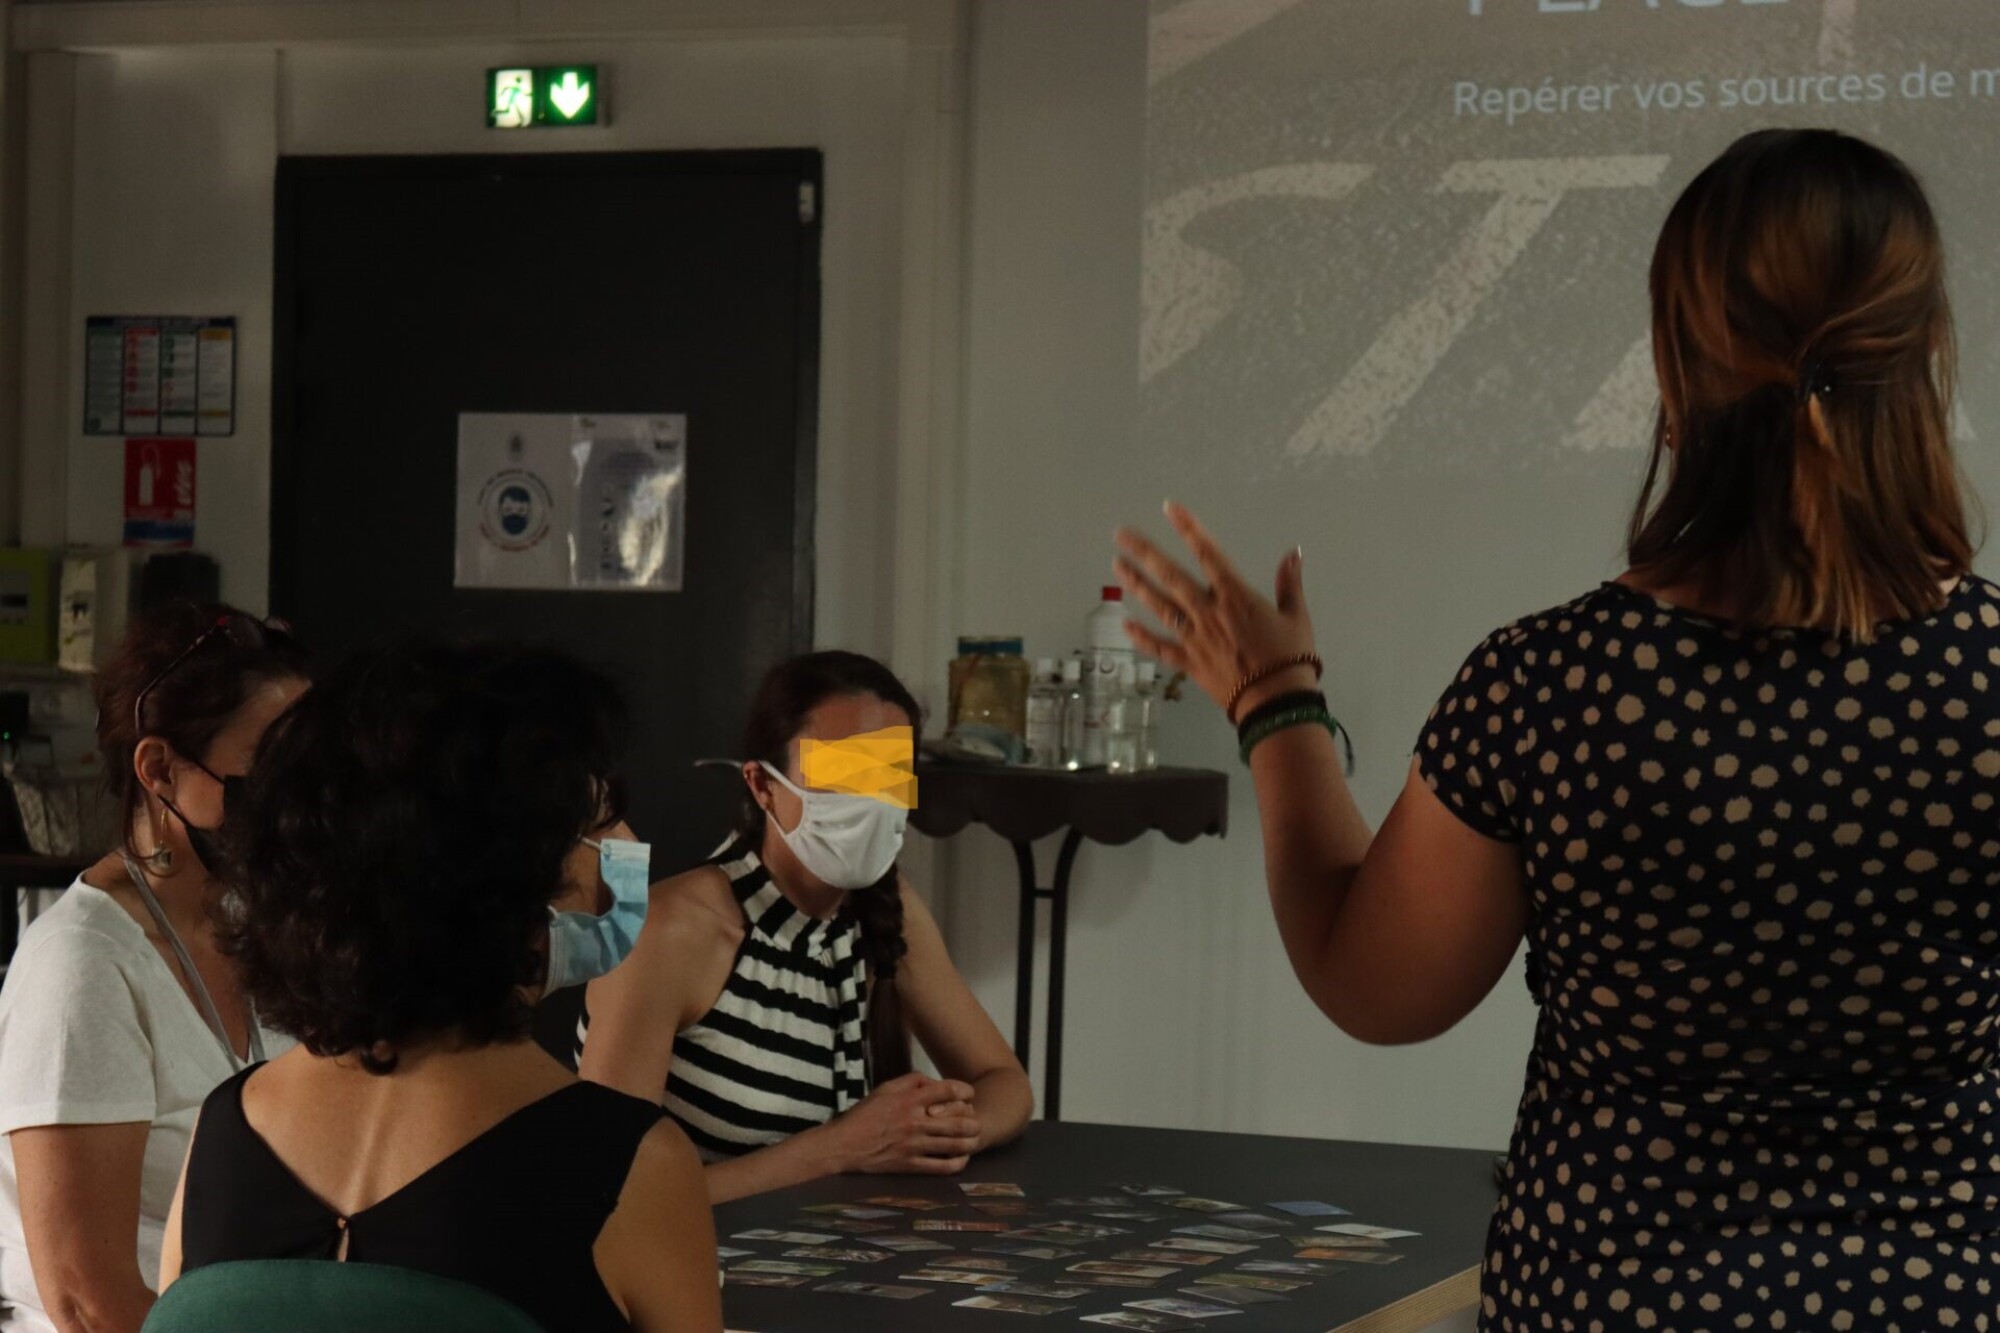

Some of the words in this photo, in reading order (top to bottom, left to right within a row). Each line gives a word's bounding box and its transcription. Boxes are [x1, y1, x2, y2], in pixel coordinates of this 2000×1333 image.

[1455, 76, 1621, 125] Repérer
[1633, 79, 1707, 108] vos
[1720, 73, 1886, 107] sources
[1901, 61, 1955, 99] de
